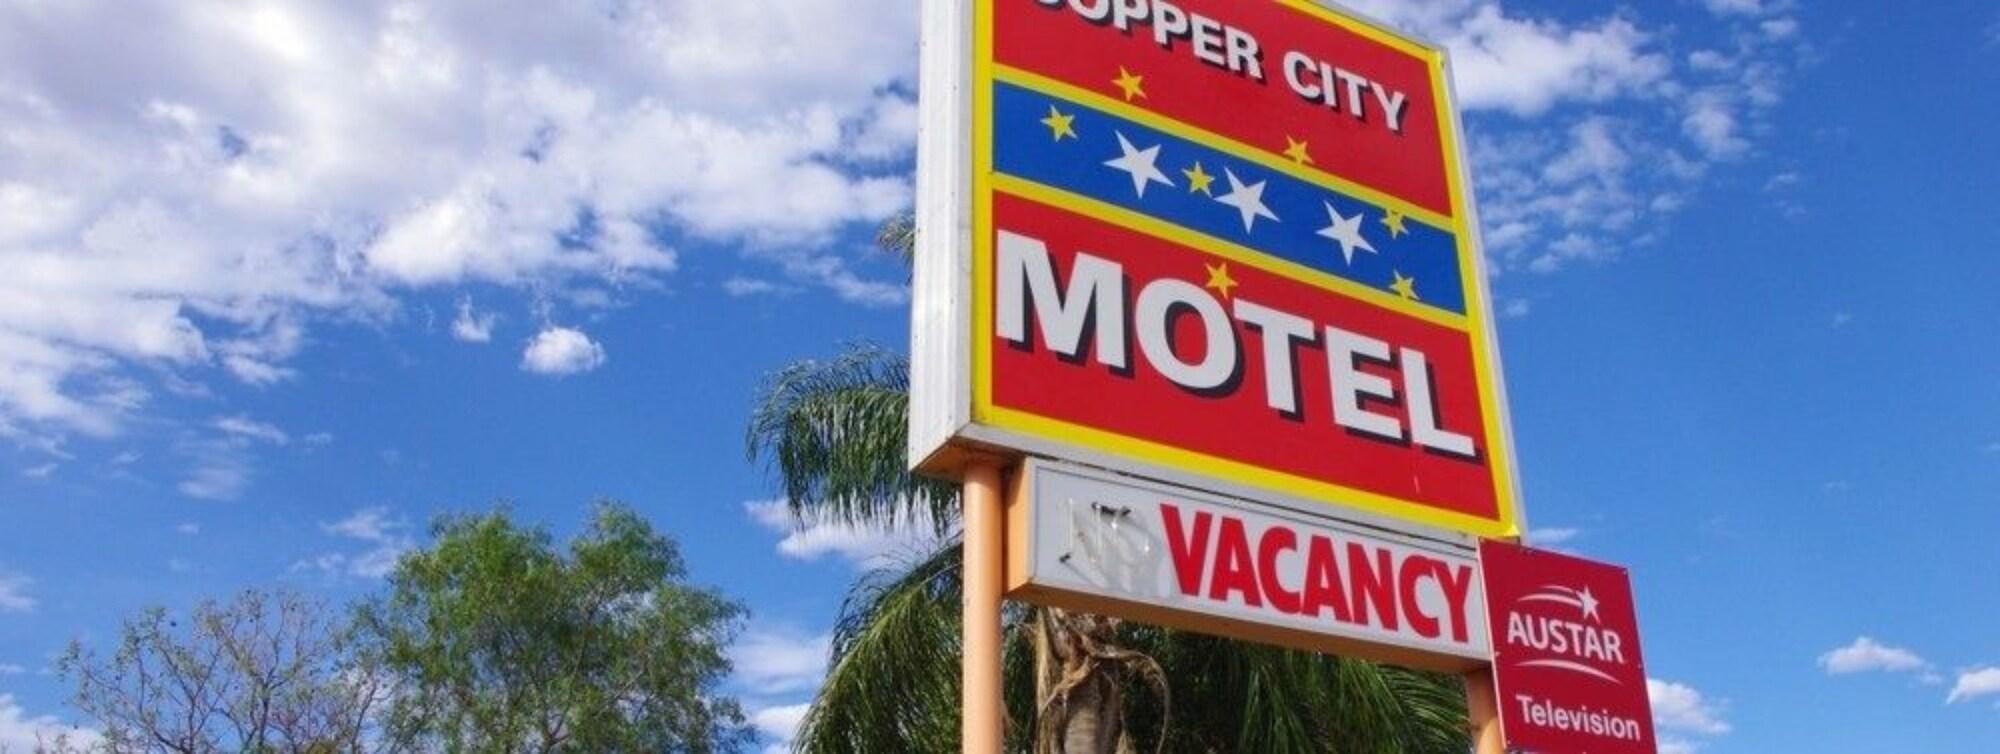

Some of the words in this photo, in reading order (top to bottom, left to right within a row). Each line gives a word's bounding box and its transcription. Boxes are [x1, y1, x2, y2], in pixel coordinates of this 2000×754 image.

[1283, 50, 1406, 131] CITY
[996, 229, 1477, 459] MOTEL
[1160, 503, 1471, 643] VACANCY
[1507, 611, 1624, 664] AUSTAR
[1515, 694, 1641, 741] Television
